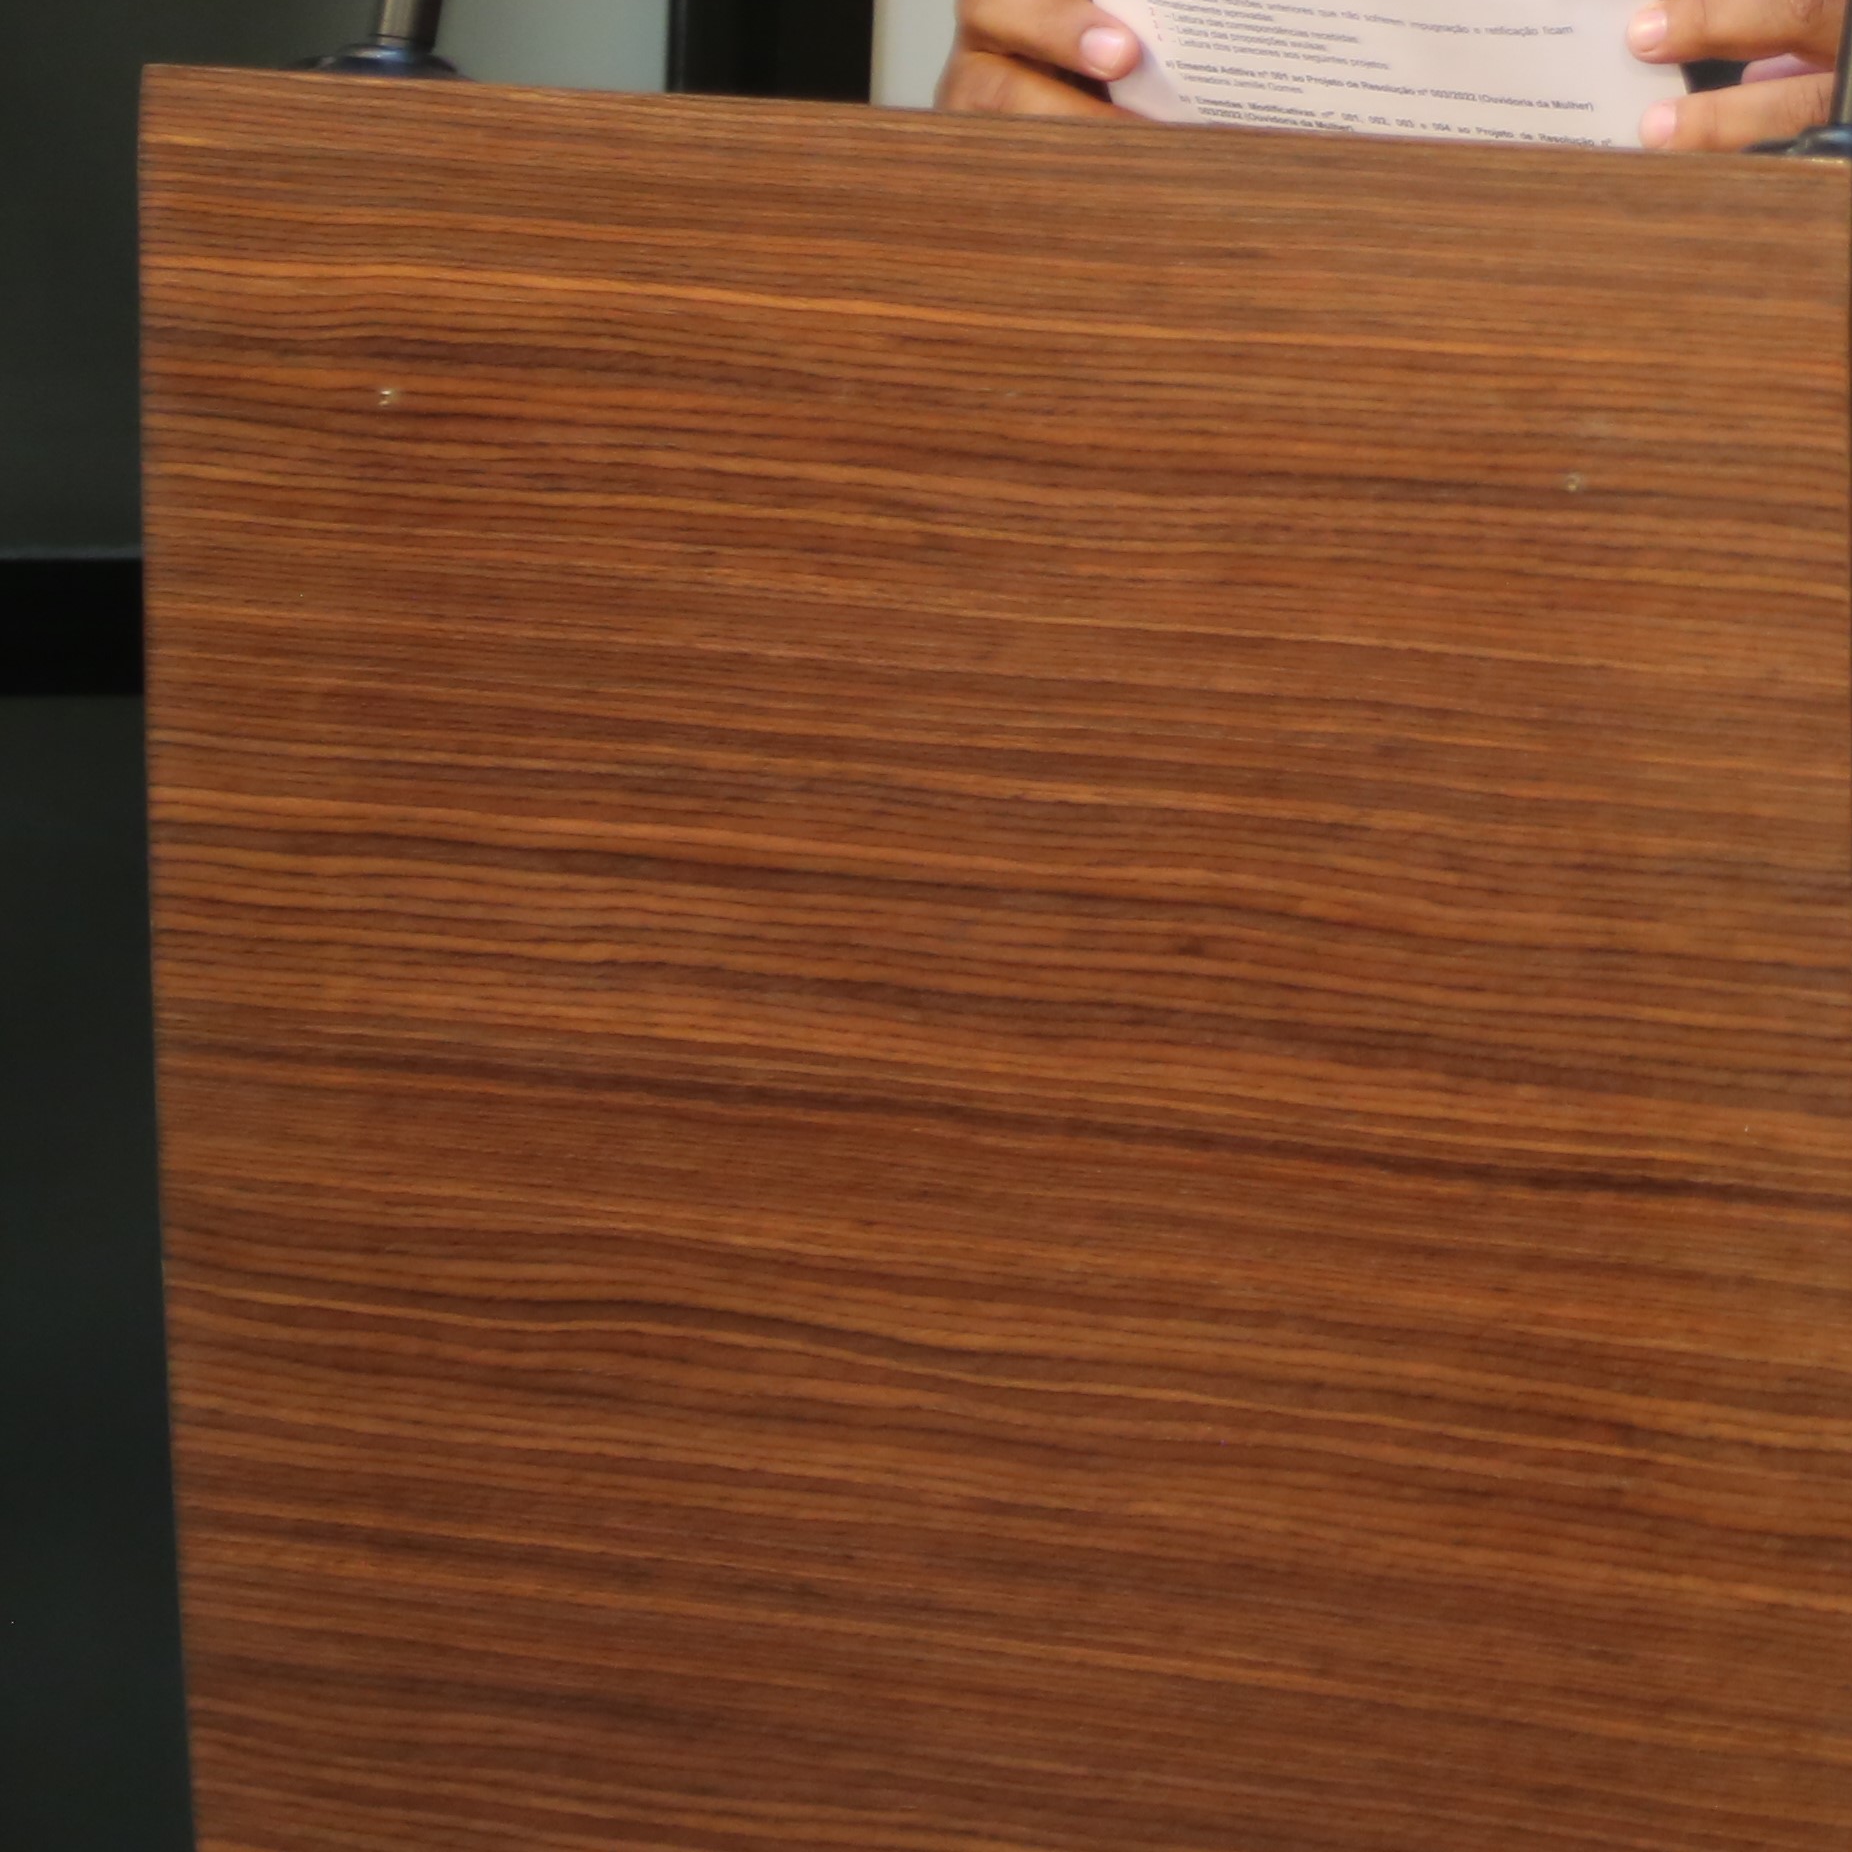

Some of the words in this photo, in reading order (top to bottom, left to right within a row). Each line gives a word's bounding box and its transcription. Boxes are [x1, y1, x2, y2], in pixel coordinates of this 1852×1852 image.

[1542, 25, 1573, 36] ficam
[1176, 60, 1219, 74] Emenda
[1305, 74, 1345, 88] Projeto
[1360, 80, 1416, 96] Resolução
[1478, 93, 1534, 107] (Ouvidoria
[1535, 98, 1550, 109] da
[1551, 100, 1595, 112] Mulher)
[1475, 127, 1515, 139] Projeto
